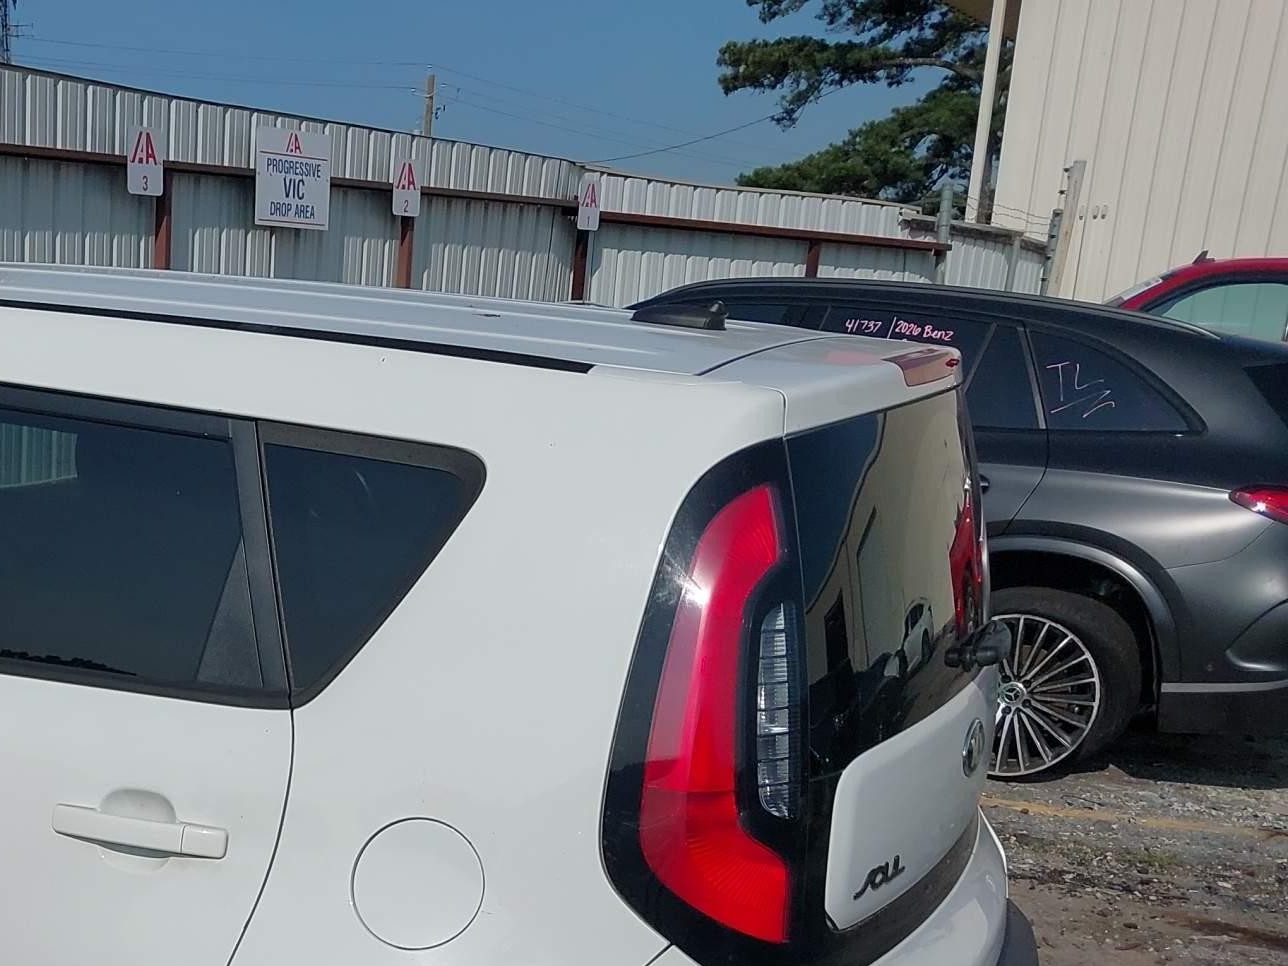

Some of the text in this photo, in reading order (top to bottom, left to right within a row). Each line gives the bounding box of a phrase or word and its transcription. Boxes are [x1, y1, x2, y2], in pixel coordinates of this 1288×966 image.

[266, 157, 321, 178] PROGRESSIVE
[142, 175, 149, 192] 3
[283, 177, 305, 200] VIC
[269, 201, 315, 219] DROP AREA
[403, 200, 409, 213] 2
[845, 319, 882, 333] 41737
[895, 320, 954, 341] 2026 Benz
